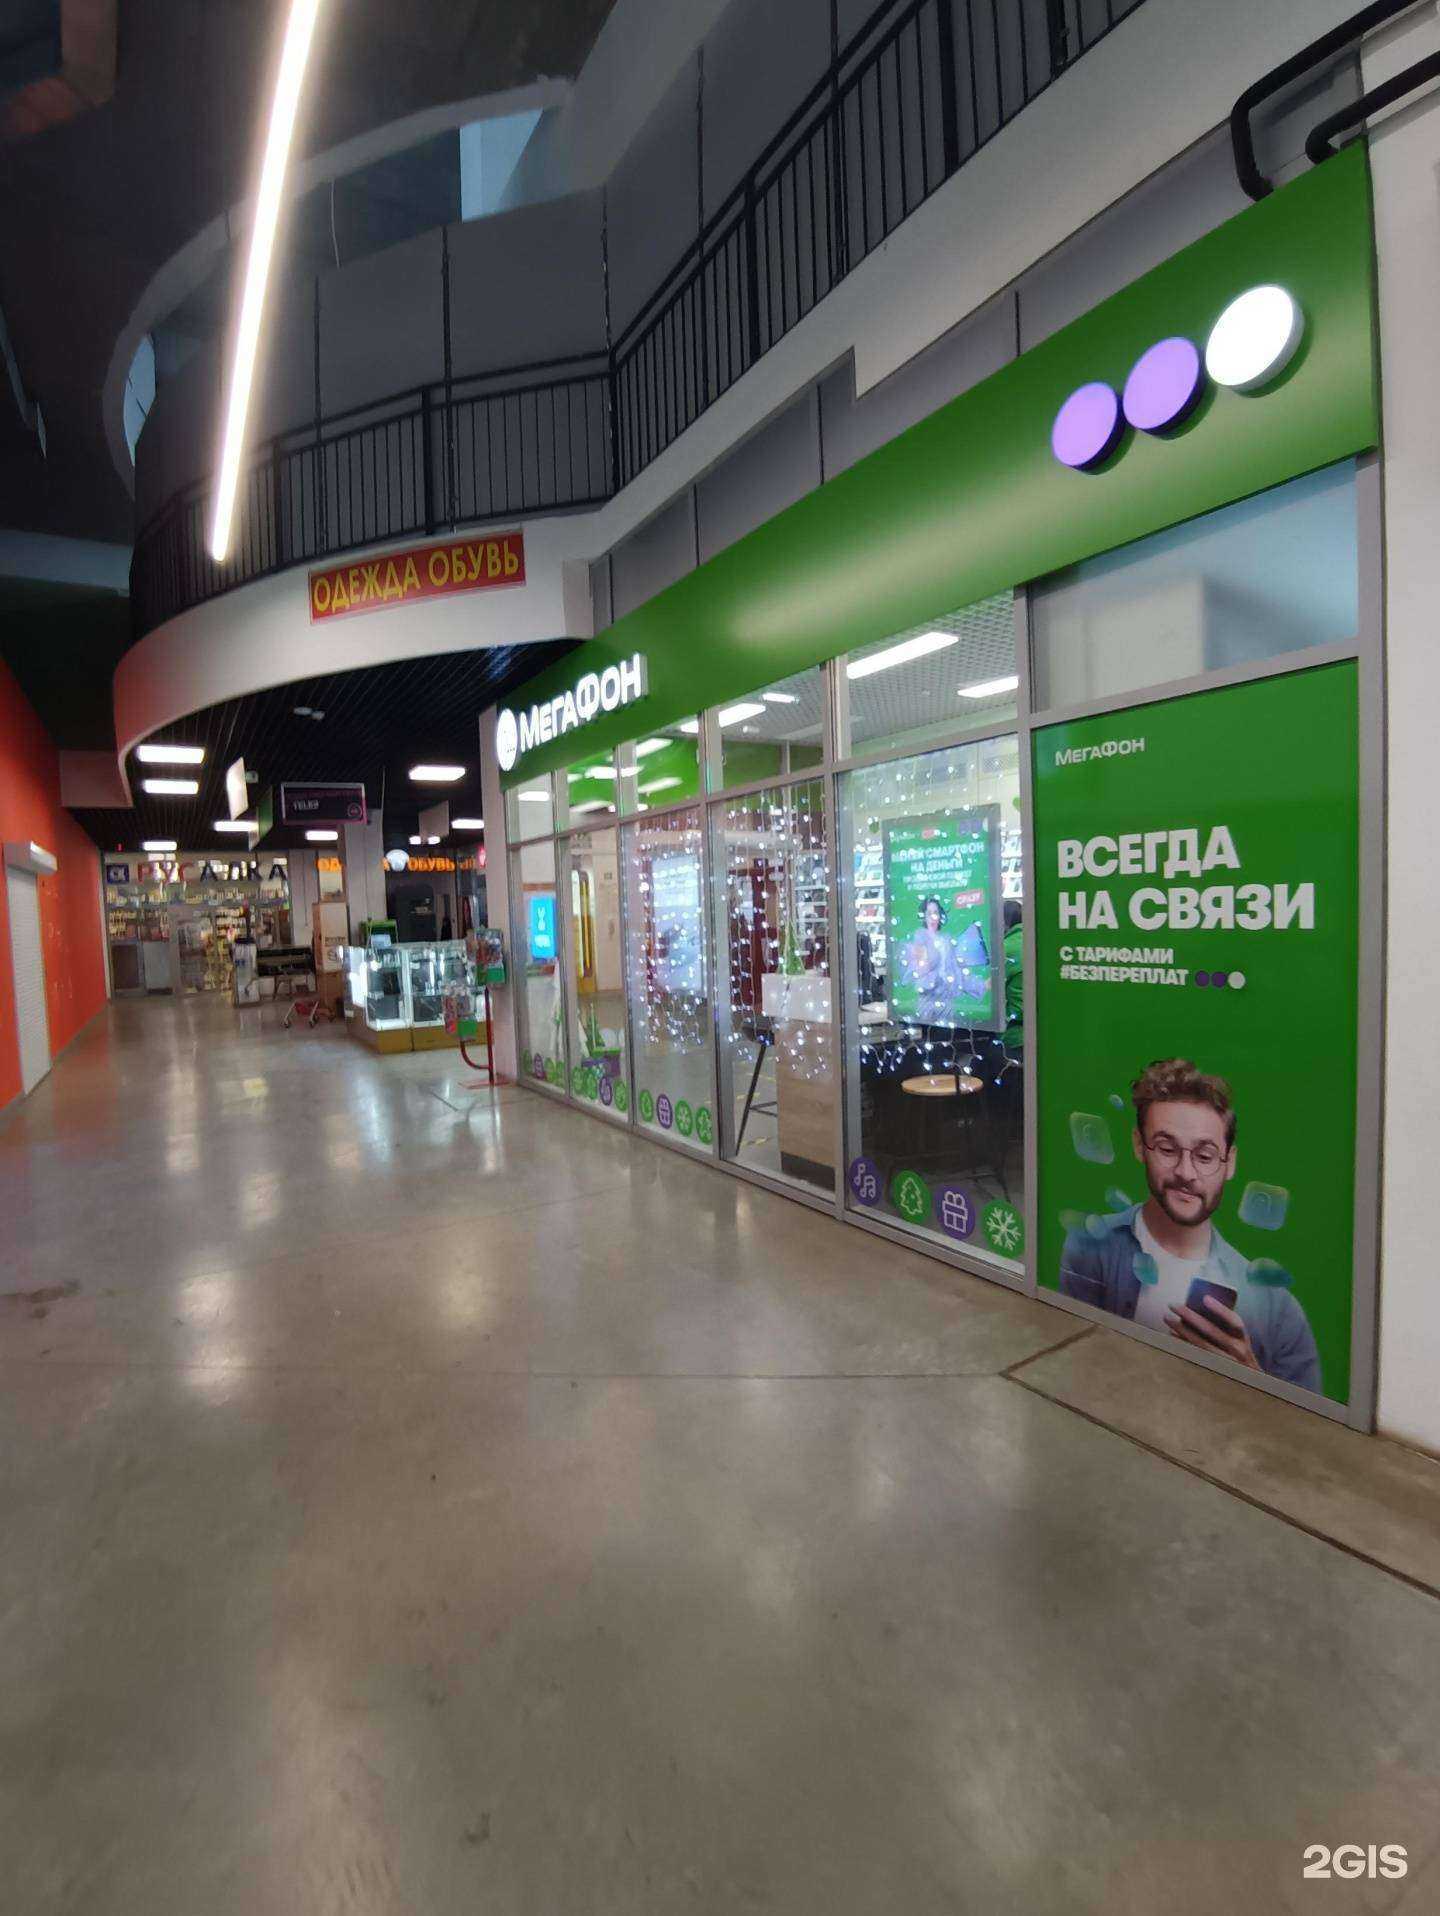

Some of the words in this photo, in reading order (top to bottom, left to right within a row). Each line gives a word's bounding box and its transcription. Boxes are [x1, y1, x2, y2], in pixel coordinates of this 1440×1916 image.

[312, 556, 422, 613] ОДЕЖДА
[428, 540, 520, 586] ОБУВЬ
[518, 651, 645, 753] МЕГАФОН
[1055, 737, 1146, 766] МЕГАФОН
[1057, 825, 1241, 879] ВСЕГДА
[1058, 890, 1120, 929] НА
[1128, 882, 1315, 931] СВЯЗИ
[1059, 945, 1074, 961] С
[1076, 945, 1174, 964] ТАРИФАМИ
[1060, 965, 1189, 985] #БЕЗПЕРЕПЛАТ
